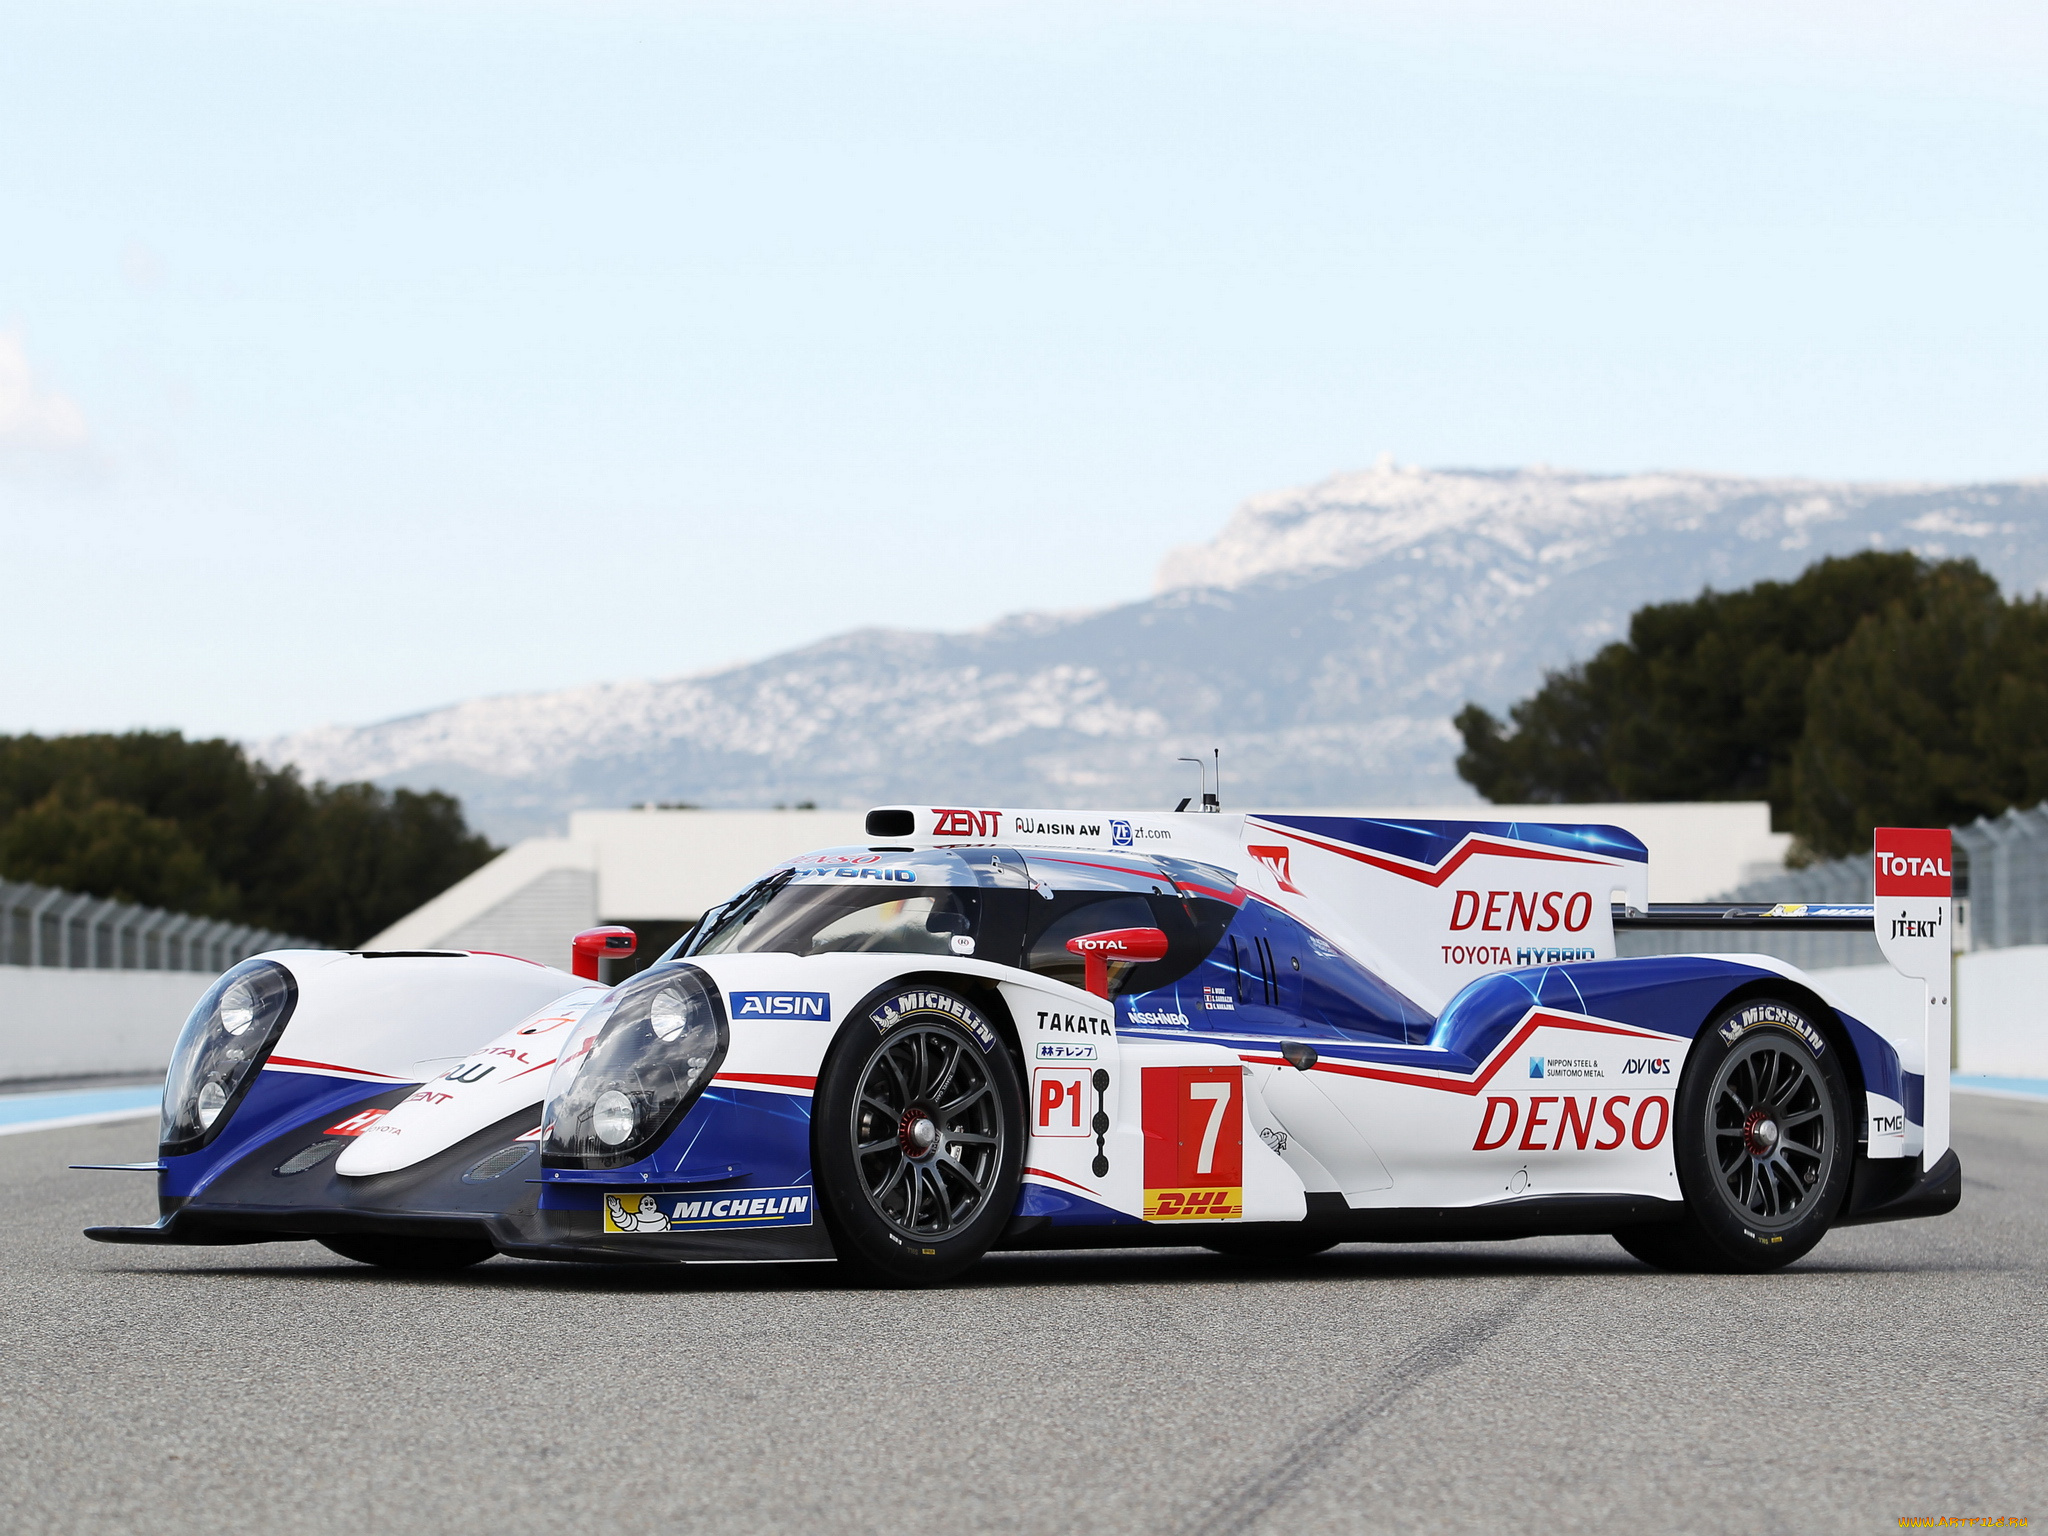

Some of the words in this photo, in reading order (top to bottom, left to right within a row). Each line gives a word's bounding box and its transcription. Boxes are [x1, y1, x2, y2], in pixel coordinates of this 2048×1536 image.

[931, 809, 1002, 837] ZENT
[1037, 823, 1075, 835] AISIN
[1079, 825, 1101, 836] AW
[1113, 823, 1132, 841] ZF
[1134, 827, 1172, 839] zf.com
[1877, 852, 1951, 876] TOTAL
[1449, 890, 1593, 932] DENSO
[1890, 918, 1937, 940] JTEKT
[1074, 938, 1128, 950] TOTAL
[1441, 946, 1512, 965] TOYOTA
[1516, 947, 1595, 965] HYBRID
[740, 996, 823, 1015] AISIN
[898, 992, 994, 1044] MICHELIN
[1037, 1011, 1112, 1036] TAKATA
[1742, 1006, 1824, 1050] MICHELIN
[472, 1047, 529, 1064] OTAL
[1041, 1046, 1094, 1058] 林テレンプ
[1547, 1059, 1573, 1067] NIPPON
[1547, 1069, 1583, 1078] SUMITOMO
[1583, 1069, 1605, 1078] METAL
[1621, 1058, 1671, 1075] ADVICS
[1039, 1079, 1082, 1127] P1
[1190, 1082, 1231, 1174] 7
[1472, 1095, 1670, 1151] DENSO
[1873, 1115, 1903, 1132] TMG
[672, 1196, 809, 1219] MICHELIN
[1156, 1192, 1232, 1216] DHL
